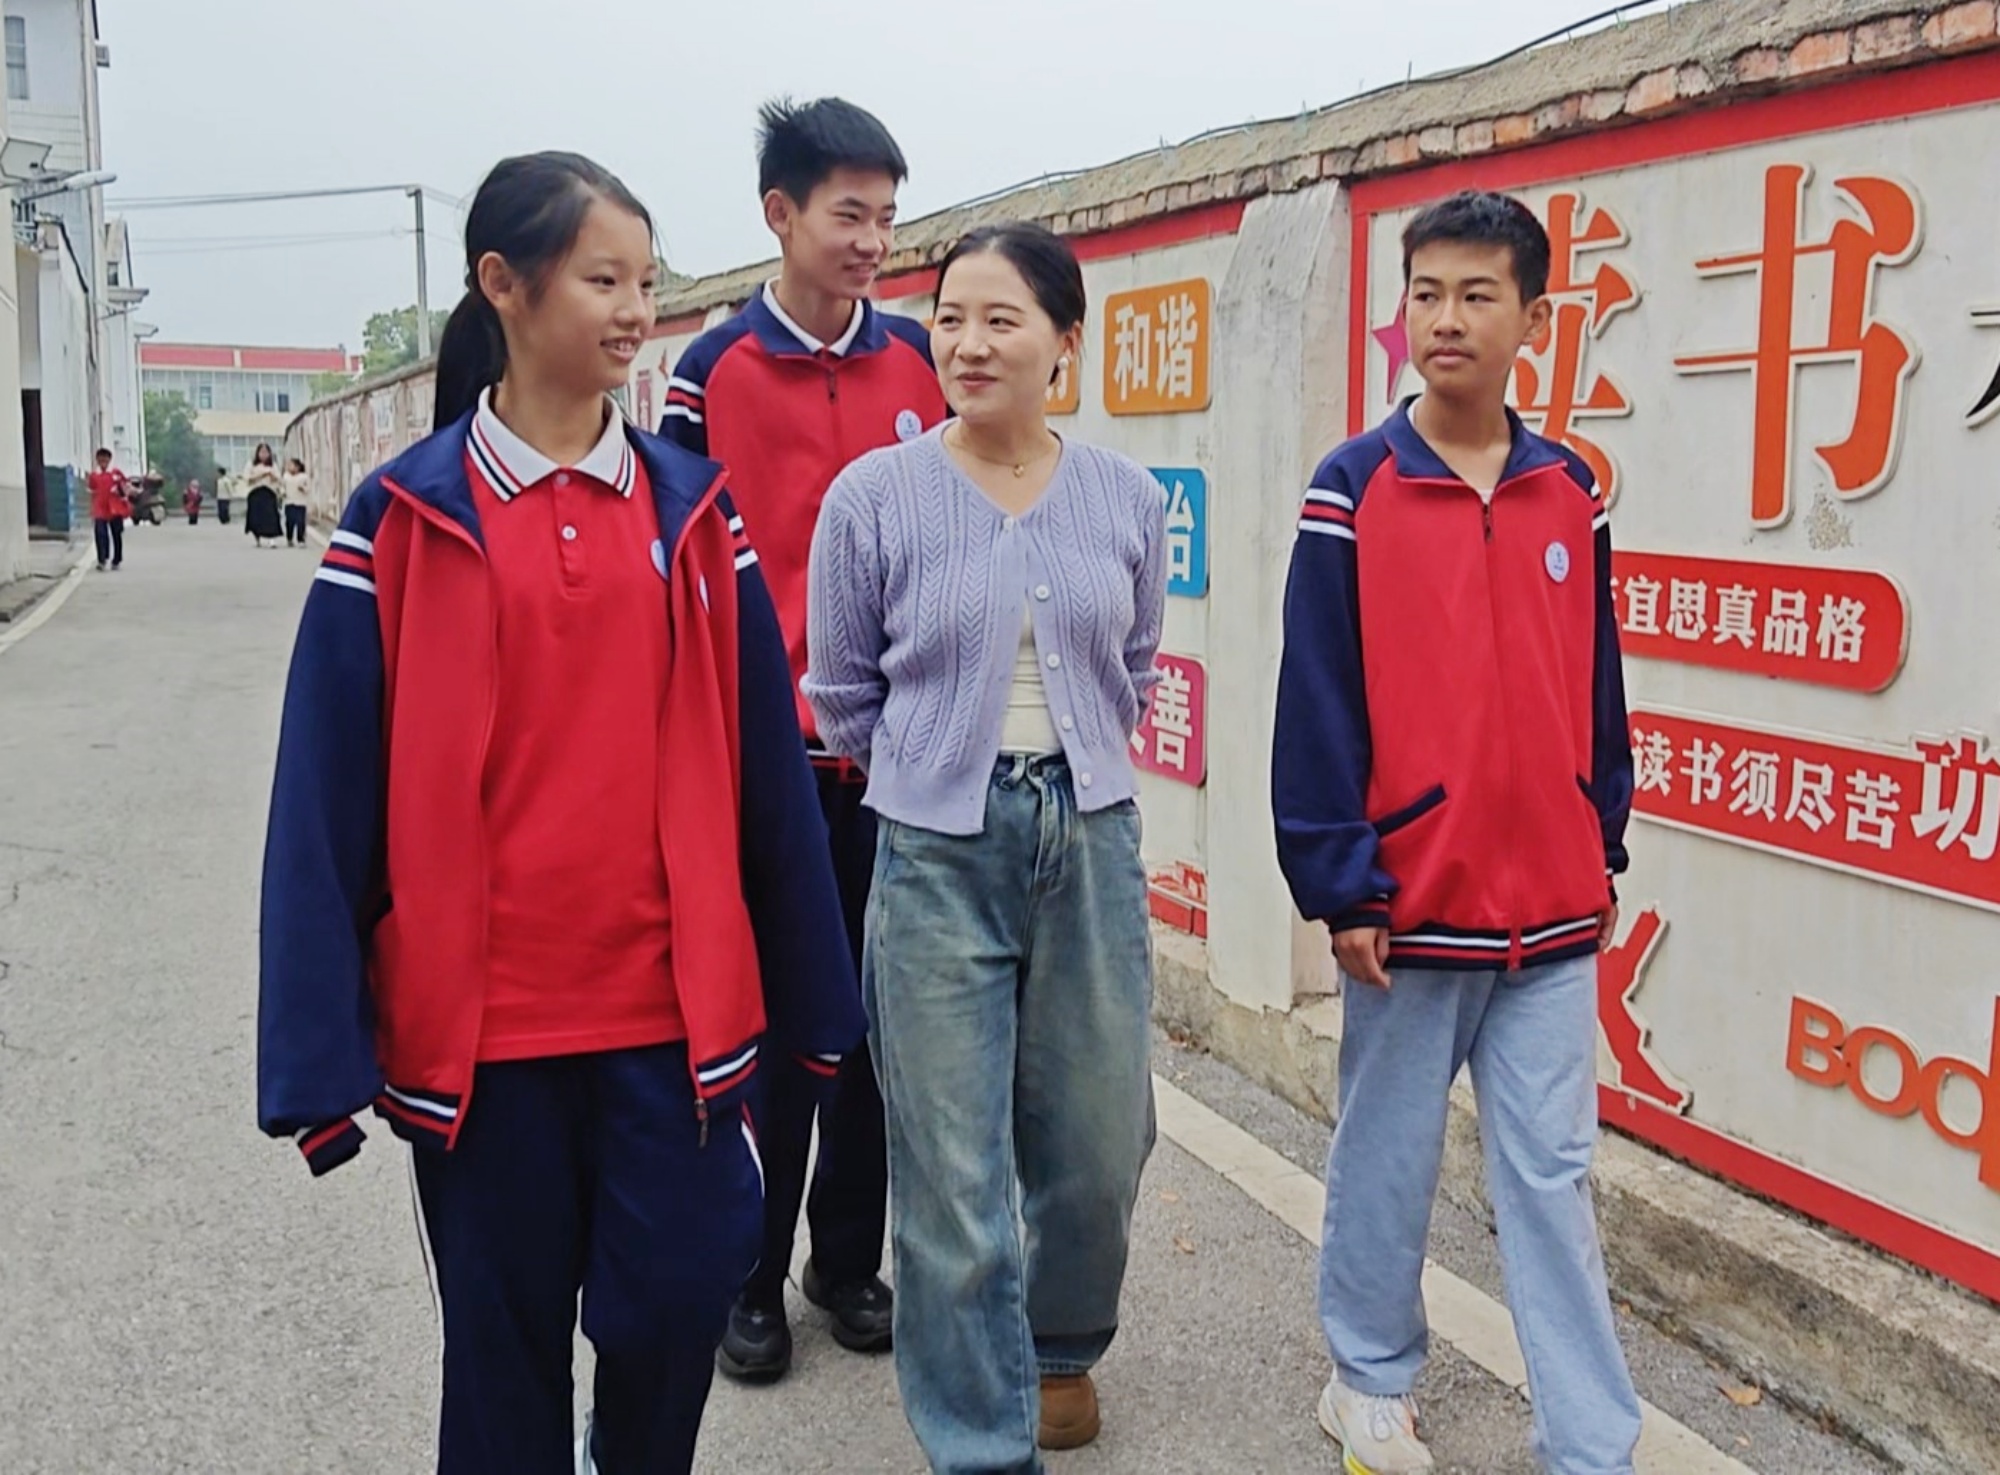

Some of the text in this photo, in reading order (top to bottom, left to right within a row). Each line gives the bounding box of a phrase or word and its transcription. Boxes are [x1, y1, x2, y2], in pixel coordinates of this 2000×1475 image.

[1114, 293, 1198, 401] 和谐
[1610, 573, 1866, 662] 宜思真品格
[1130, 665, 1192, 772] 善
